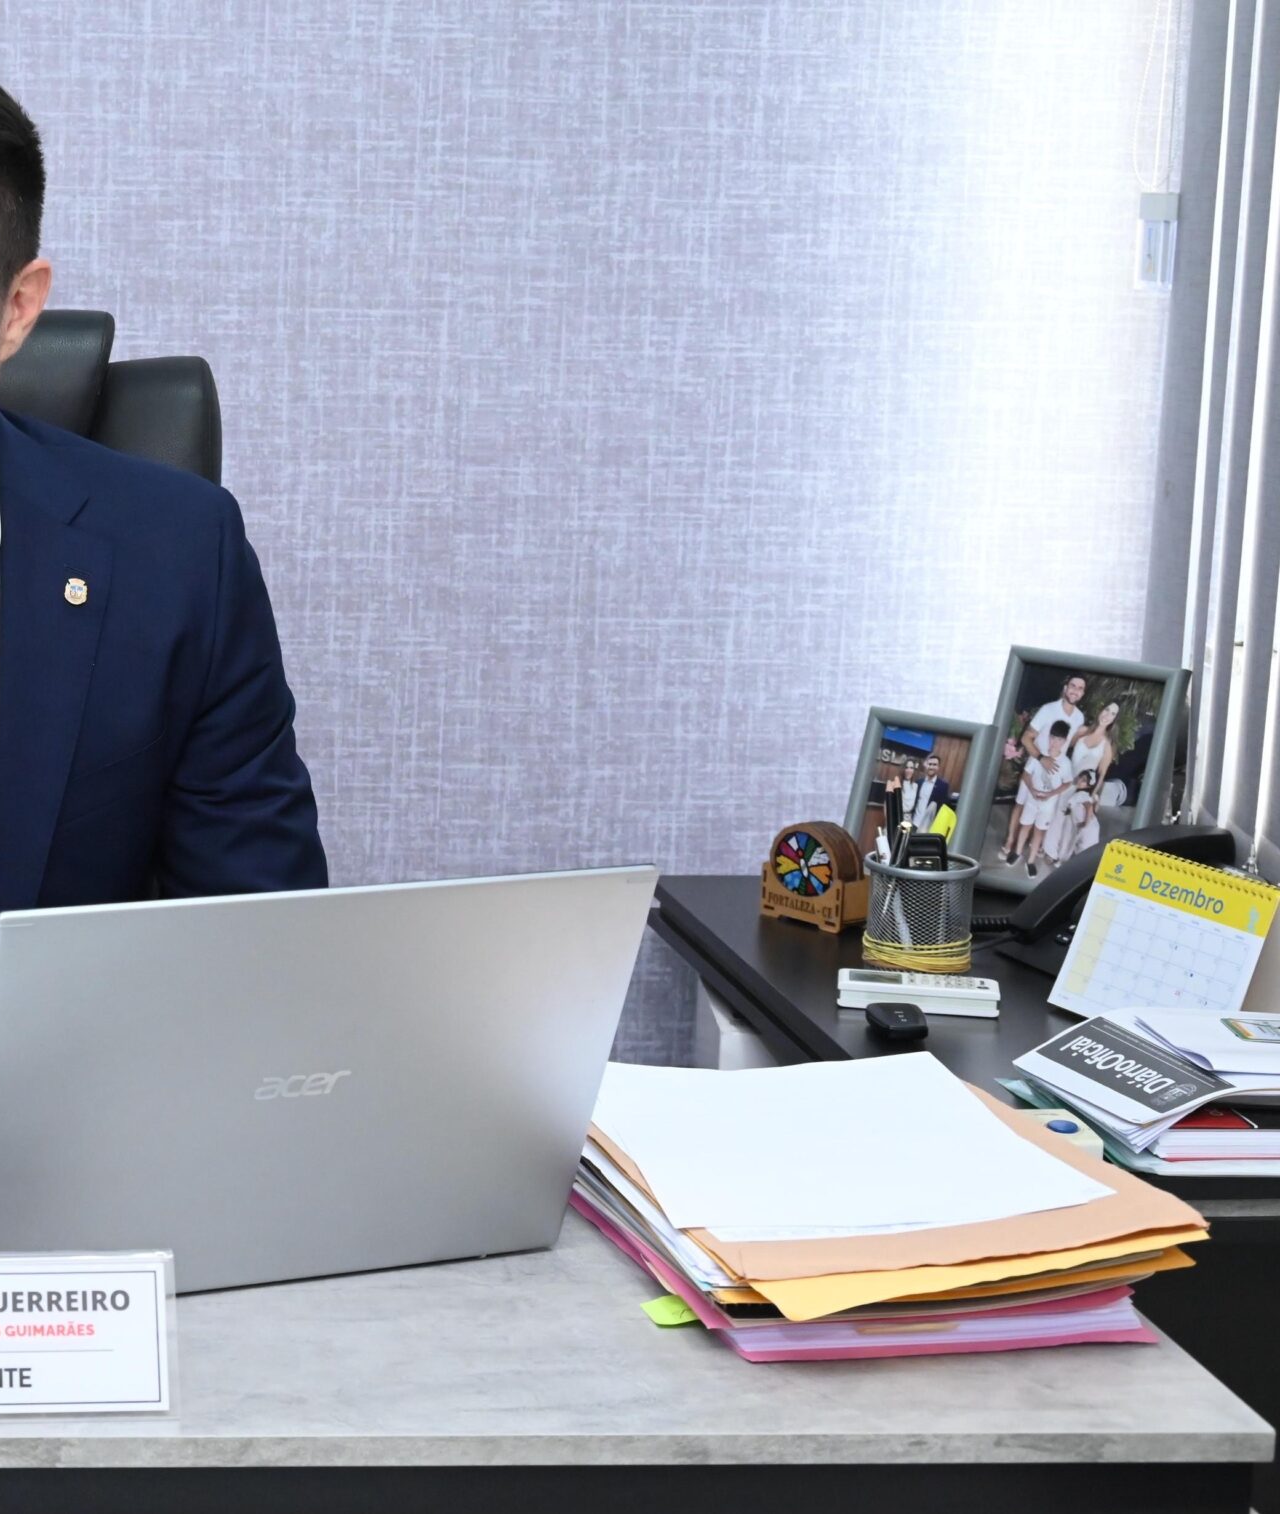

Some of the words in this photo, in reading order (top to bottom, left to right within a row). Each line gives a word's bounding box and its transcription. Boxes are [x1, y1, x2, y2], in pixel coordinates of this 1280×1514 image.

[768, 891, 816, 914] FORTALEZA
[1138, 871, 1224, 914] Dezembro
[254, 1070, 352, 1100] acer
[5, 1322, 95, 1337] GUIMARÃES
